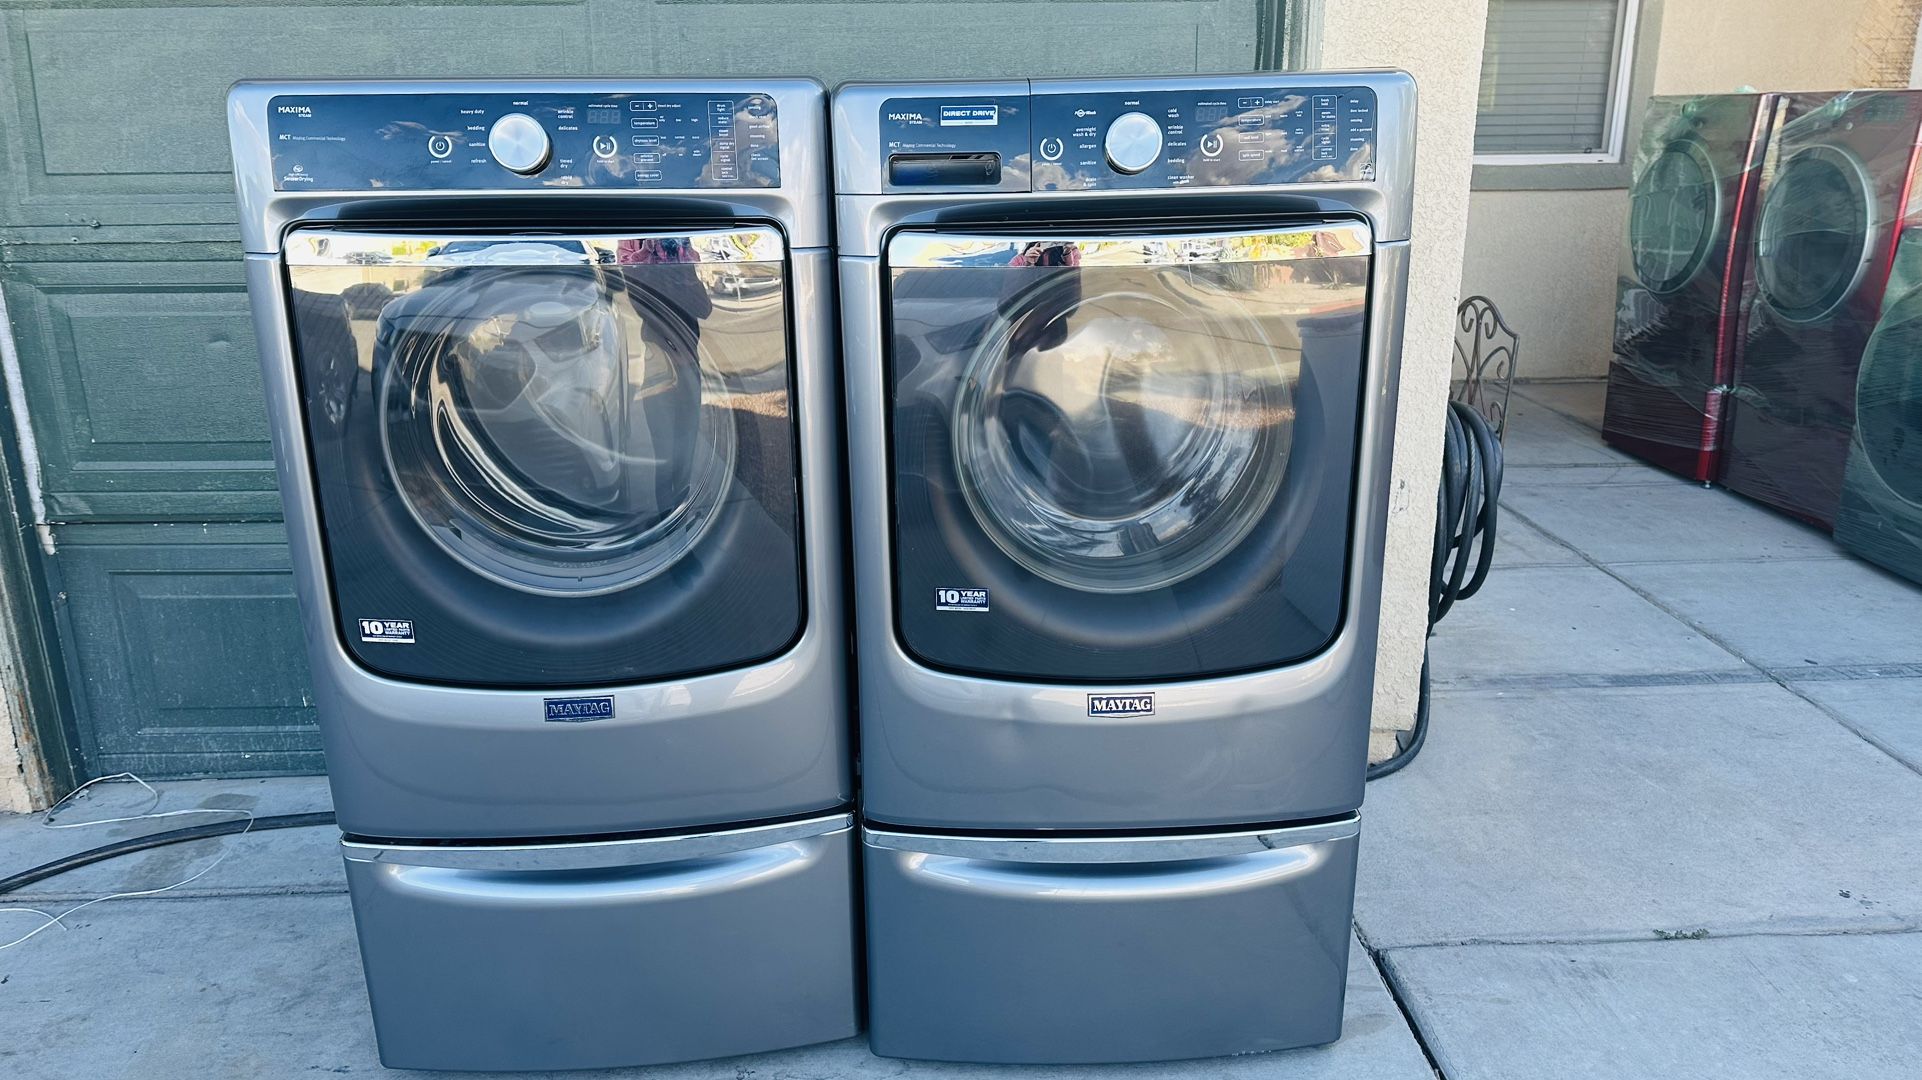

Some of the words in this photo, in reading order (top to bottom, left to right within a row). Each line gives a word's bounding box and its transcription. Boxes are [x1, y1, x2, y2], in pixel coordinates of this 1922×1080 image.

[278, 106, 311, 114] MAXIMA
[938, 590, 960, 604] 10
[361, 621, 384, 635] 10
[383, 621, 410, 629] YEAR
[549, 701, 610, 716] MAYTAG
[1093, 698, 1151, 711] MAYTAG
